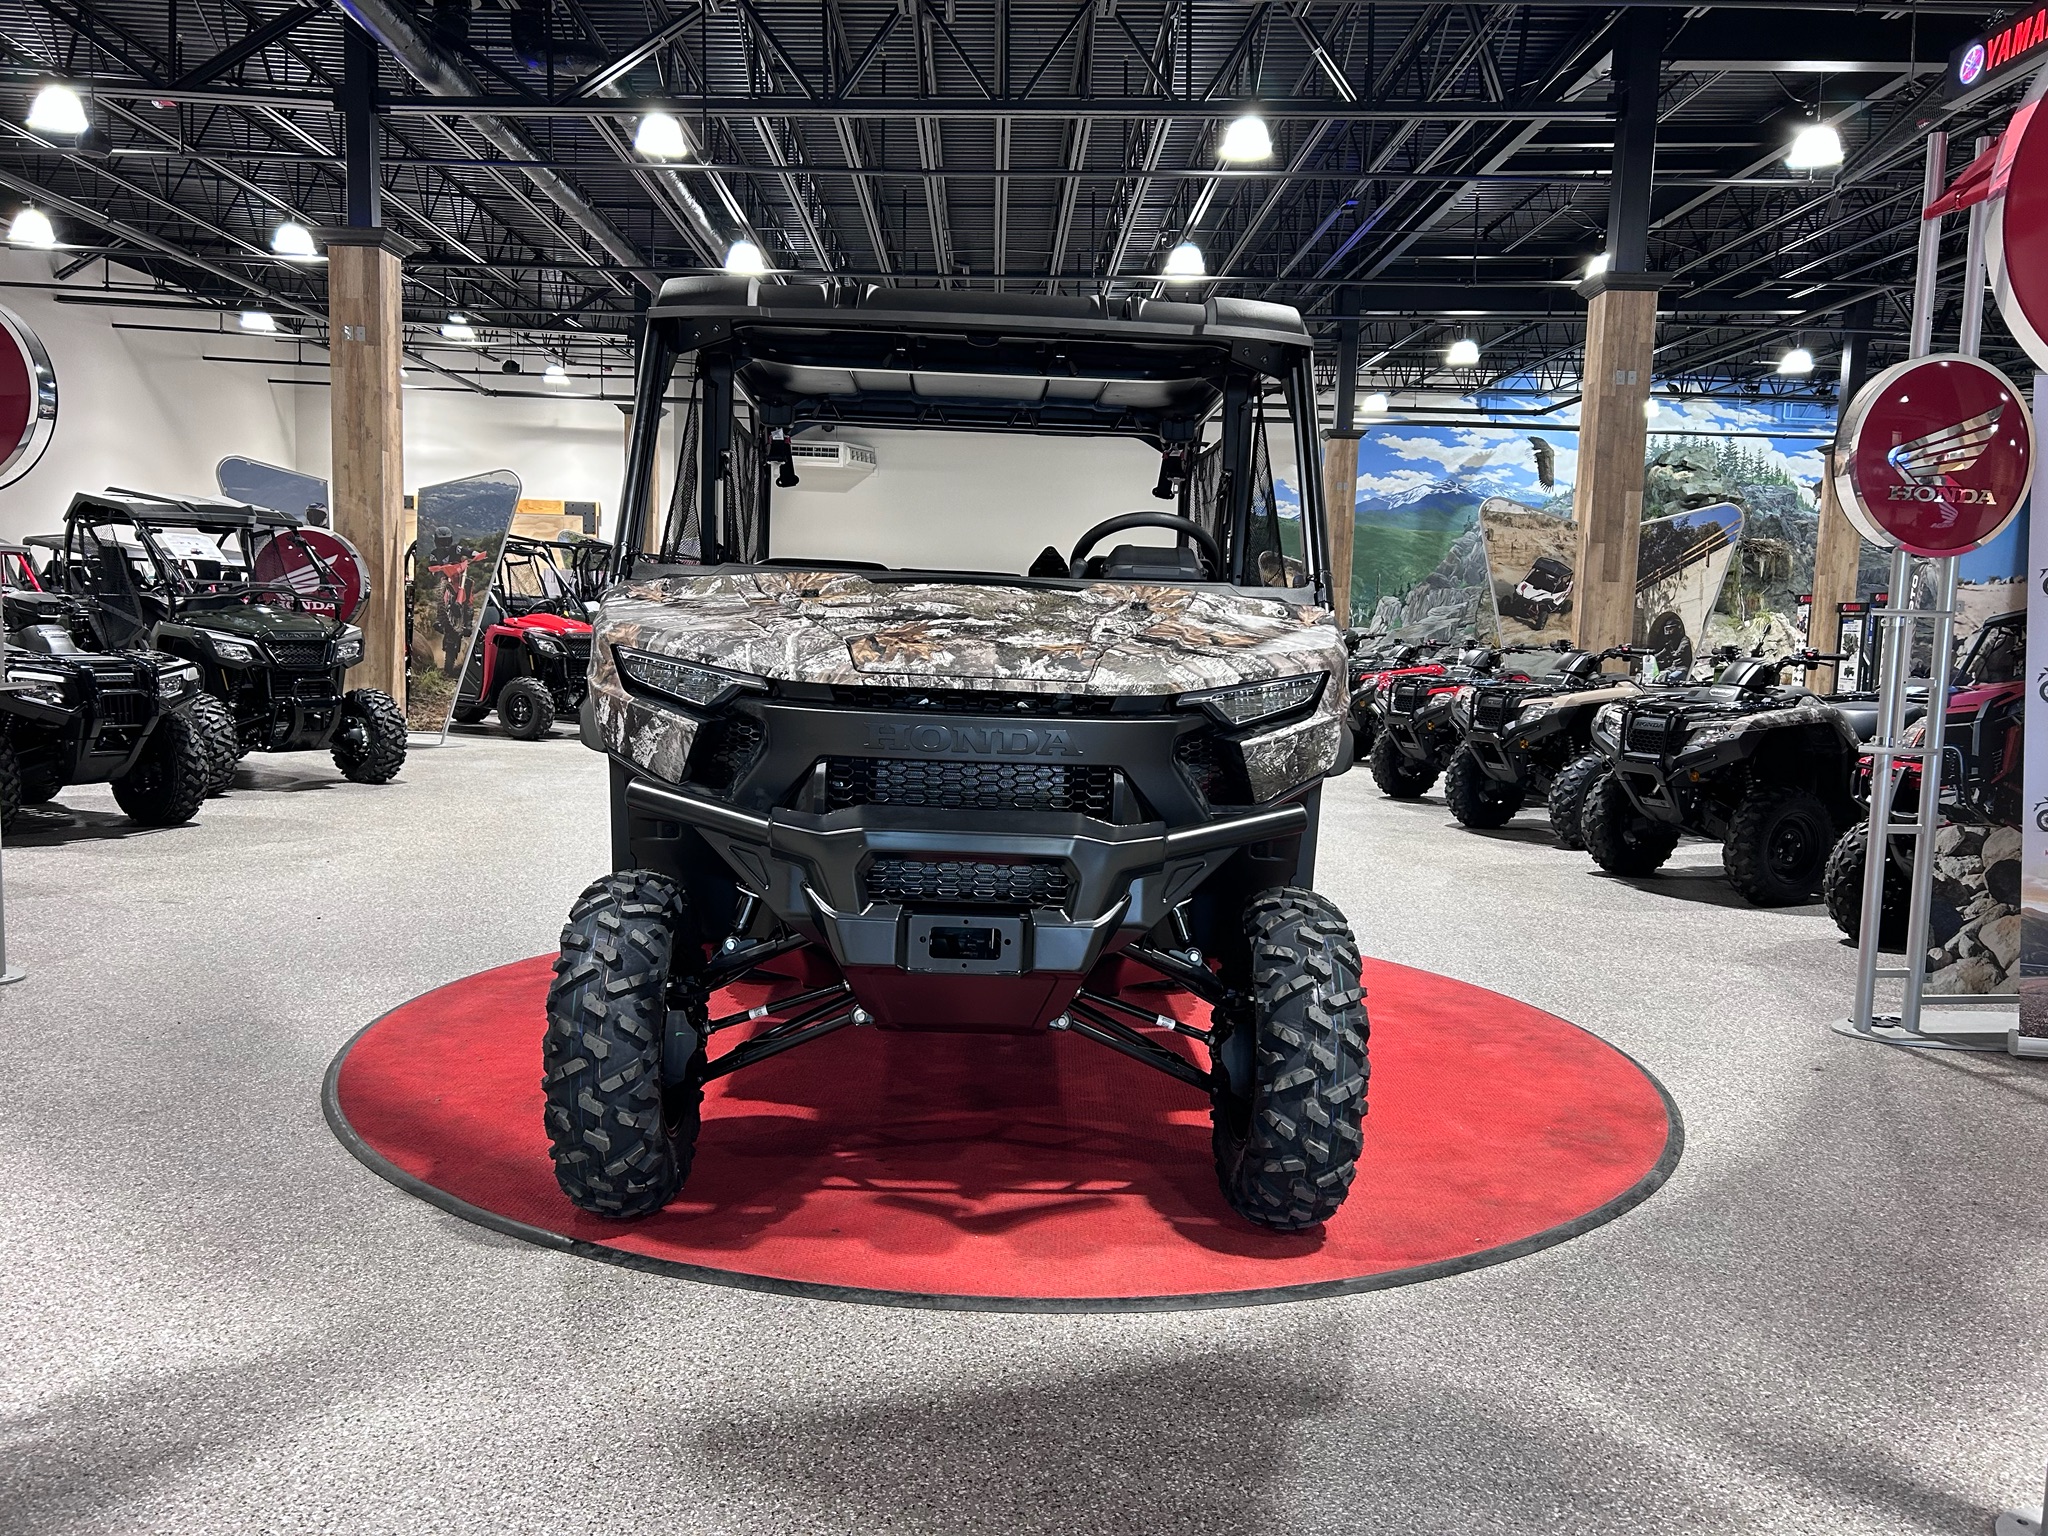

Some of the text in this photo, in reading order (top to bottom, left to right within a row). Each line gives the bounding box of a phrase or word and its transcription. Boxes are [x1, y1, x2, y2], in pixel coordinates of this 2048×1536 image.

[1986, 8, 2048, 71] YAMA
[1888, 485, 1997, 505] HONDA
[1635, 721, 1664, 729] HONDA
[863, 722, 1084, 757] HONDA
